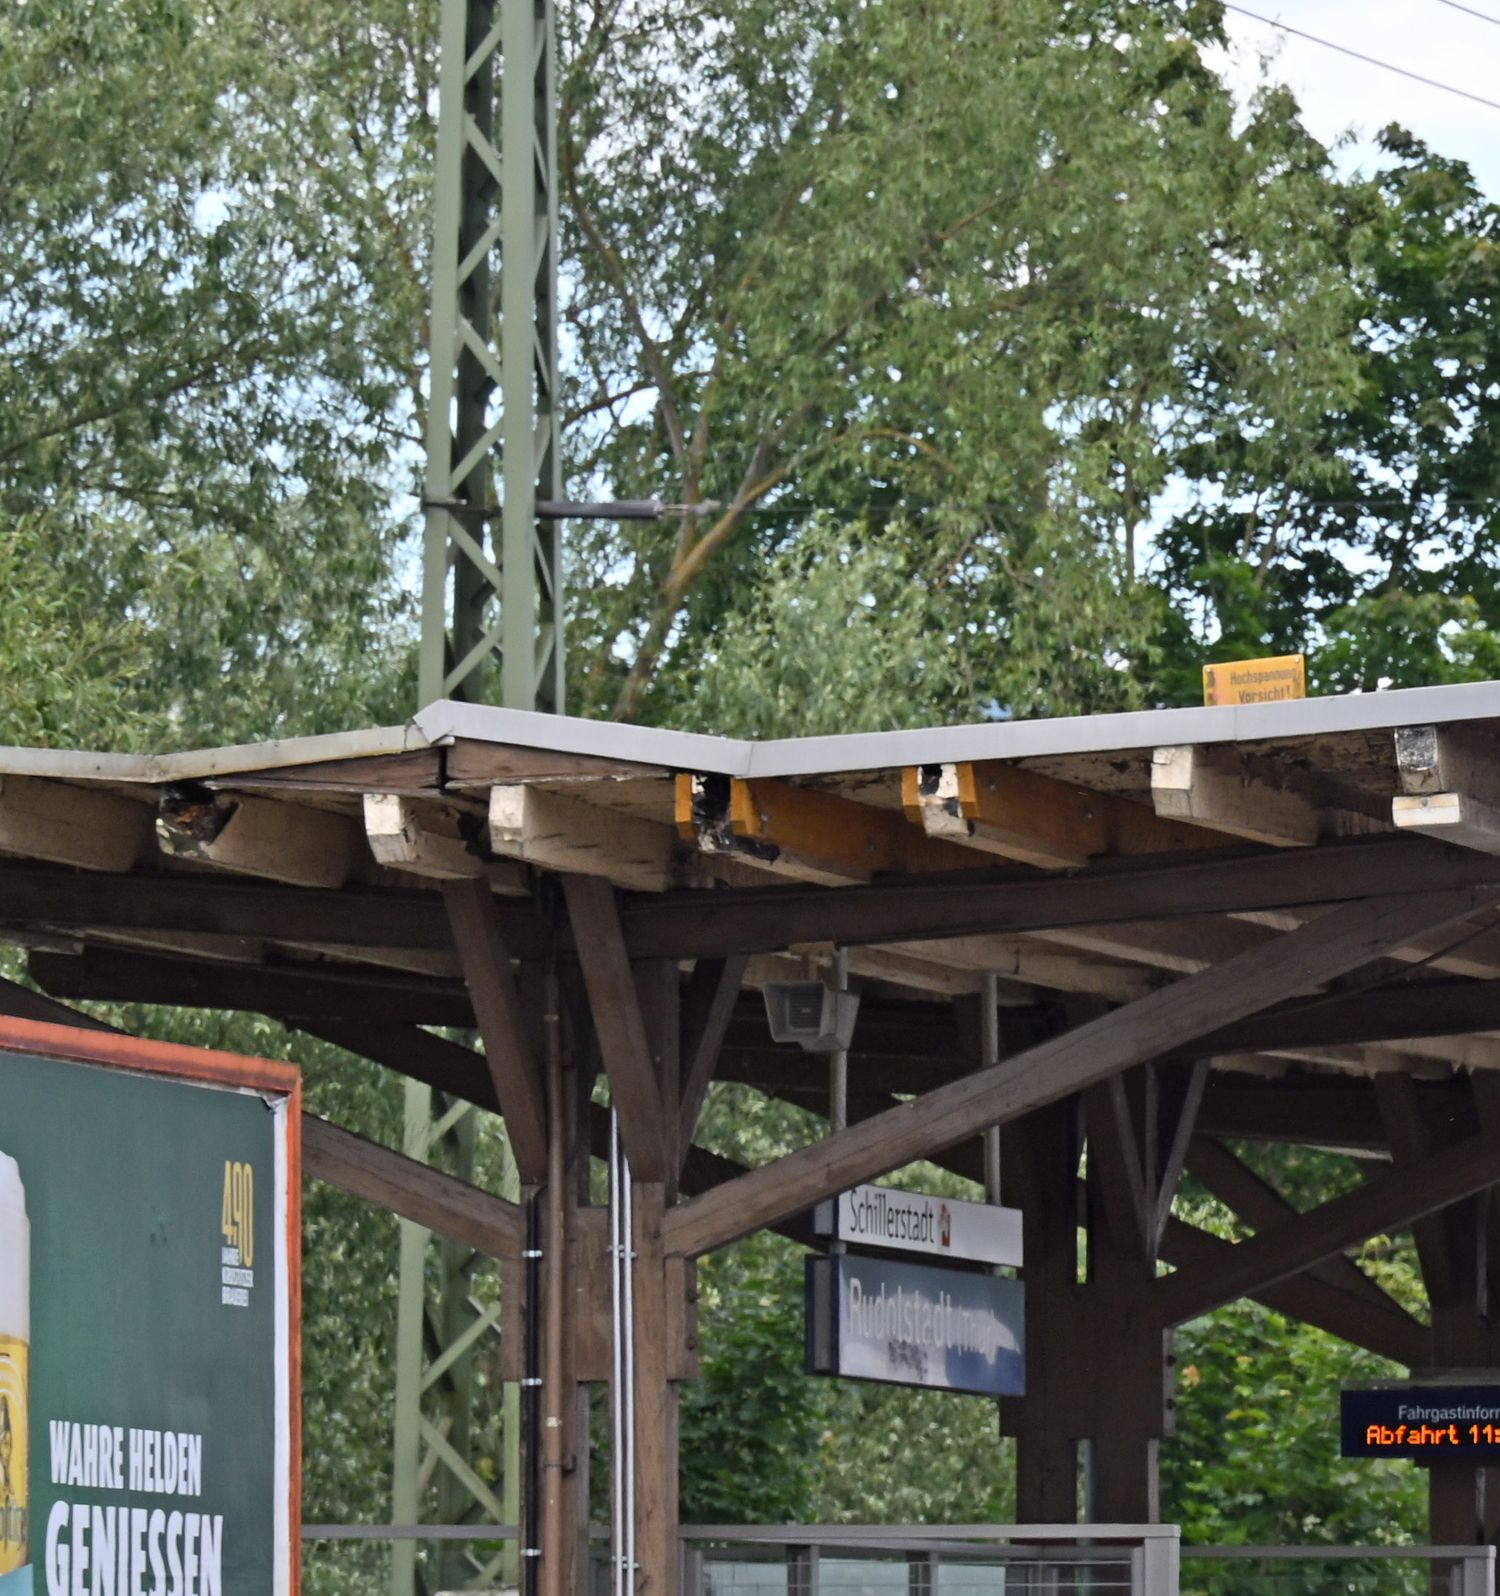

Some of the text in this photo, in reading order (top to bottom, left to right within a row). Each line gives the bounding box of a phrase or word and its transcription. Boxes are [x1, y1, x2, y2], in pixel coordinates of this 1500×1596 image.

[222, 1161, 253, 1267] 490
[850, 1190, 934, 1244] Schillerstadt
[49, 1420, 201, 1496] WAHRE HELDEN
[1366, 1425, 1459, 1445] Abfahrt
